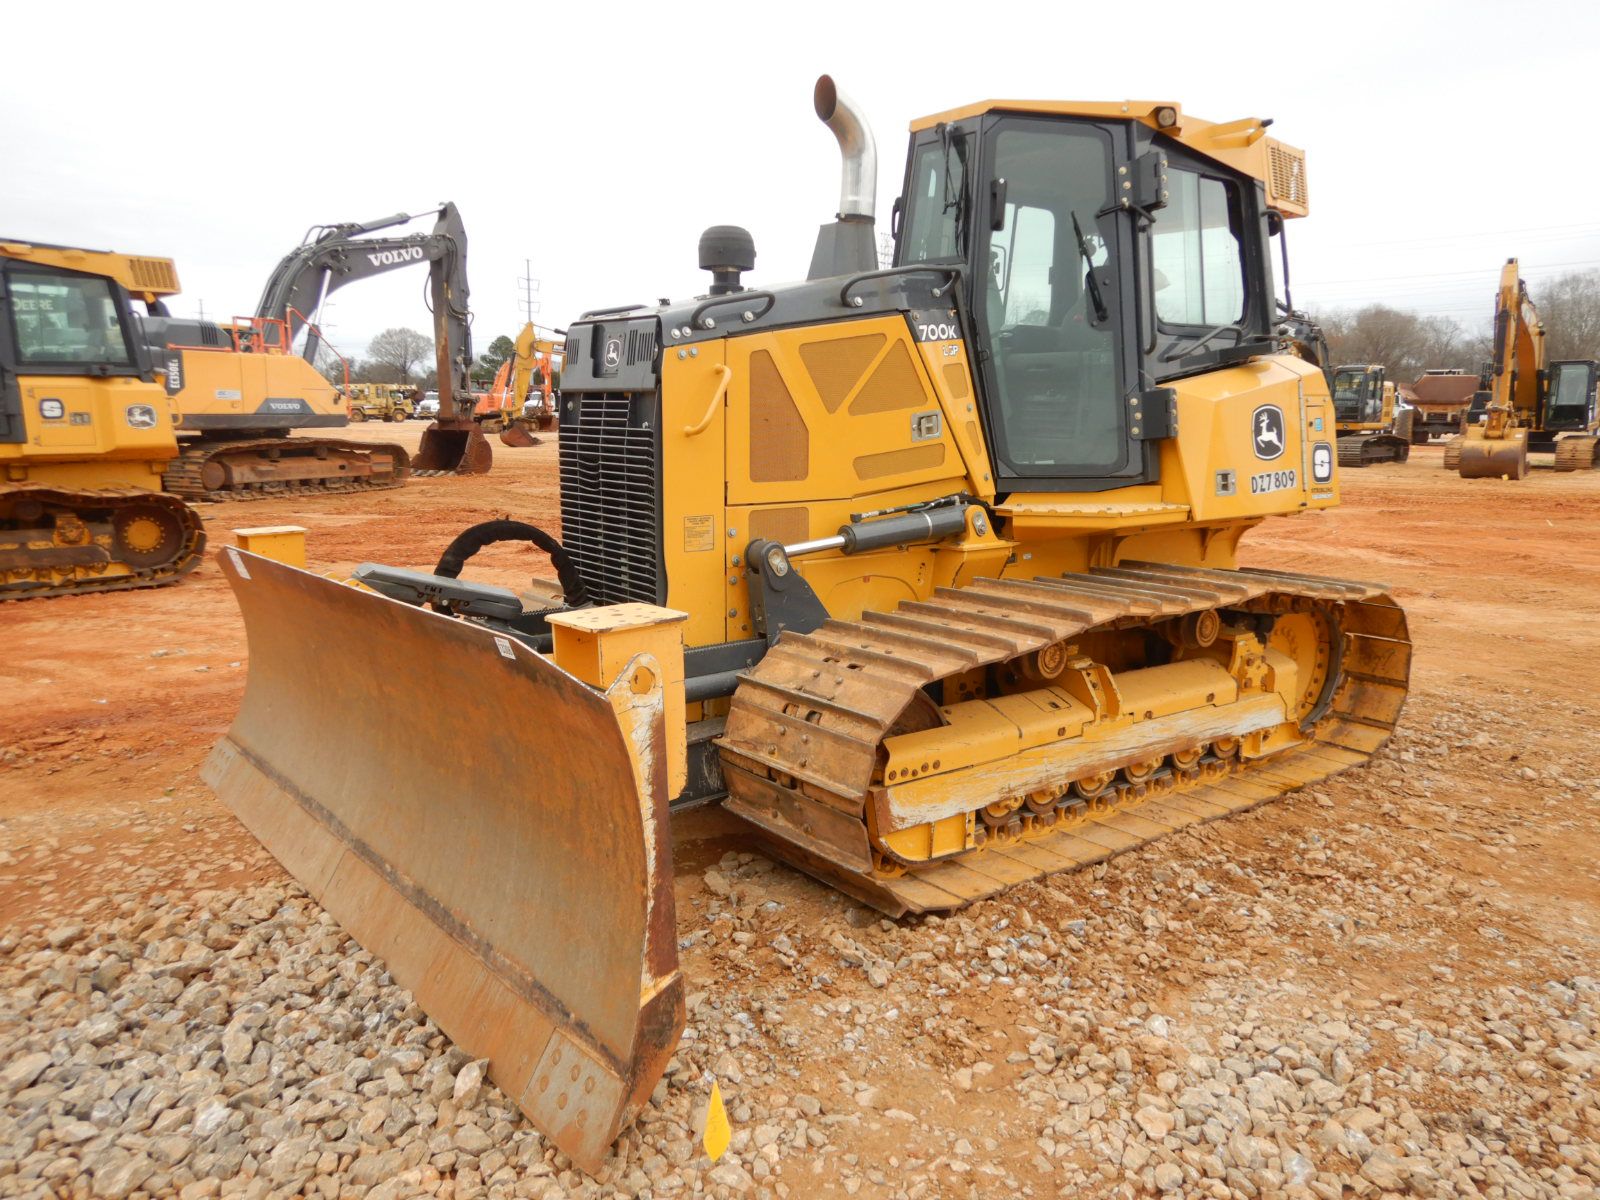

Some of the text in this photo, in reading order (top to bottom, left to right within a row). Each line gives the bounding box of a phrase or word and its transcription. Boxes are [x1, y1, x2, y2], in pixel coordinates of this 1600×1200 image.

[367, 246, 423, 266] VOLVO
[918, 323, 957, 341] 700K
[269, 402, 300, 410] VOLVO
